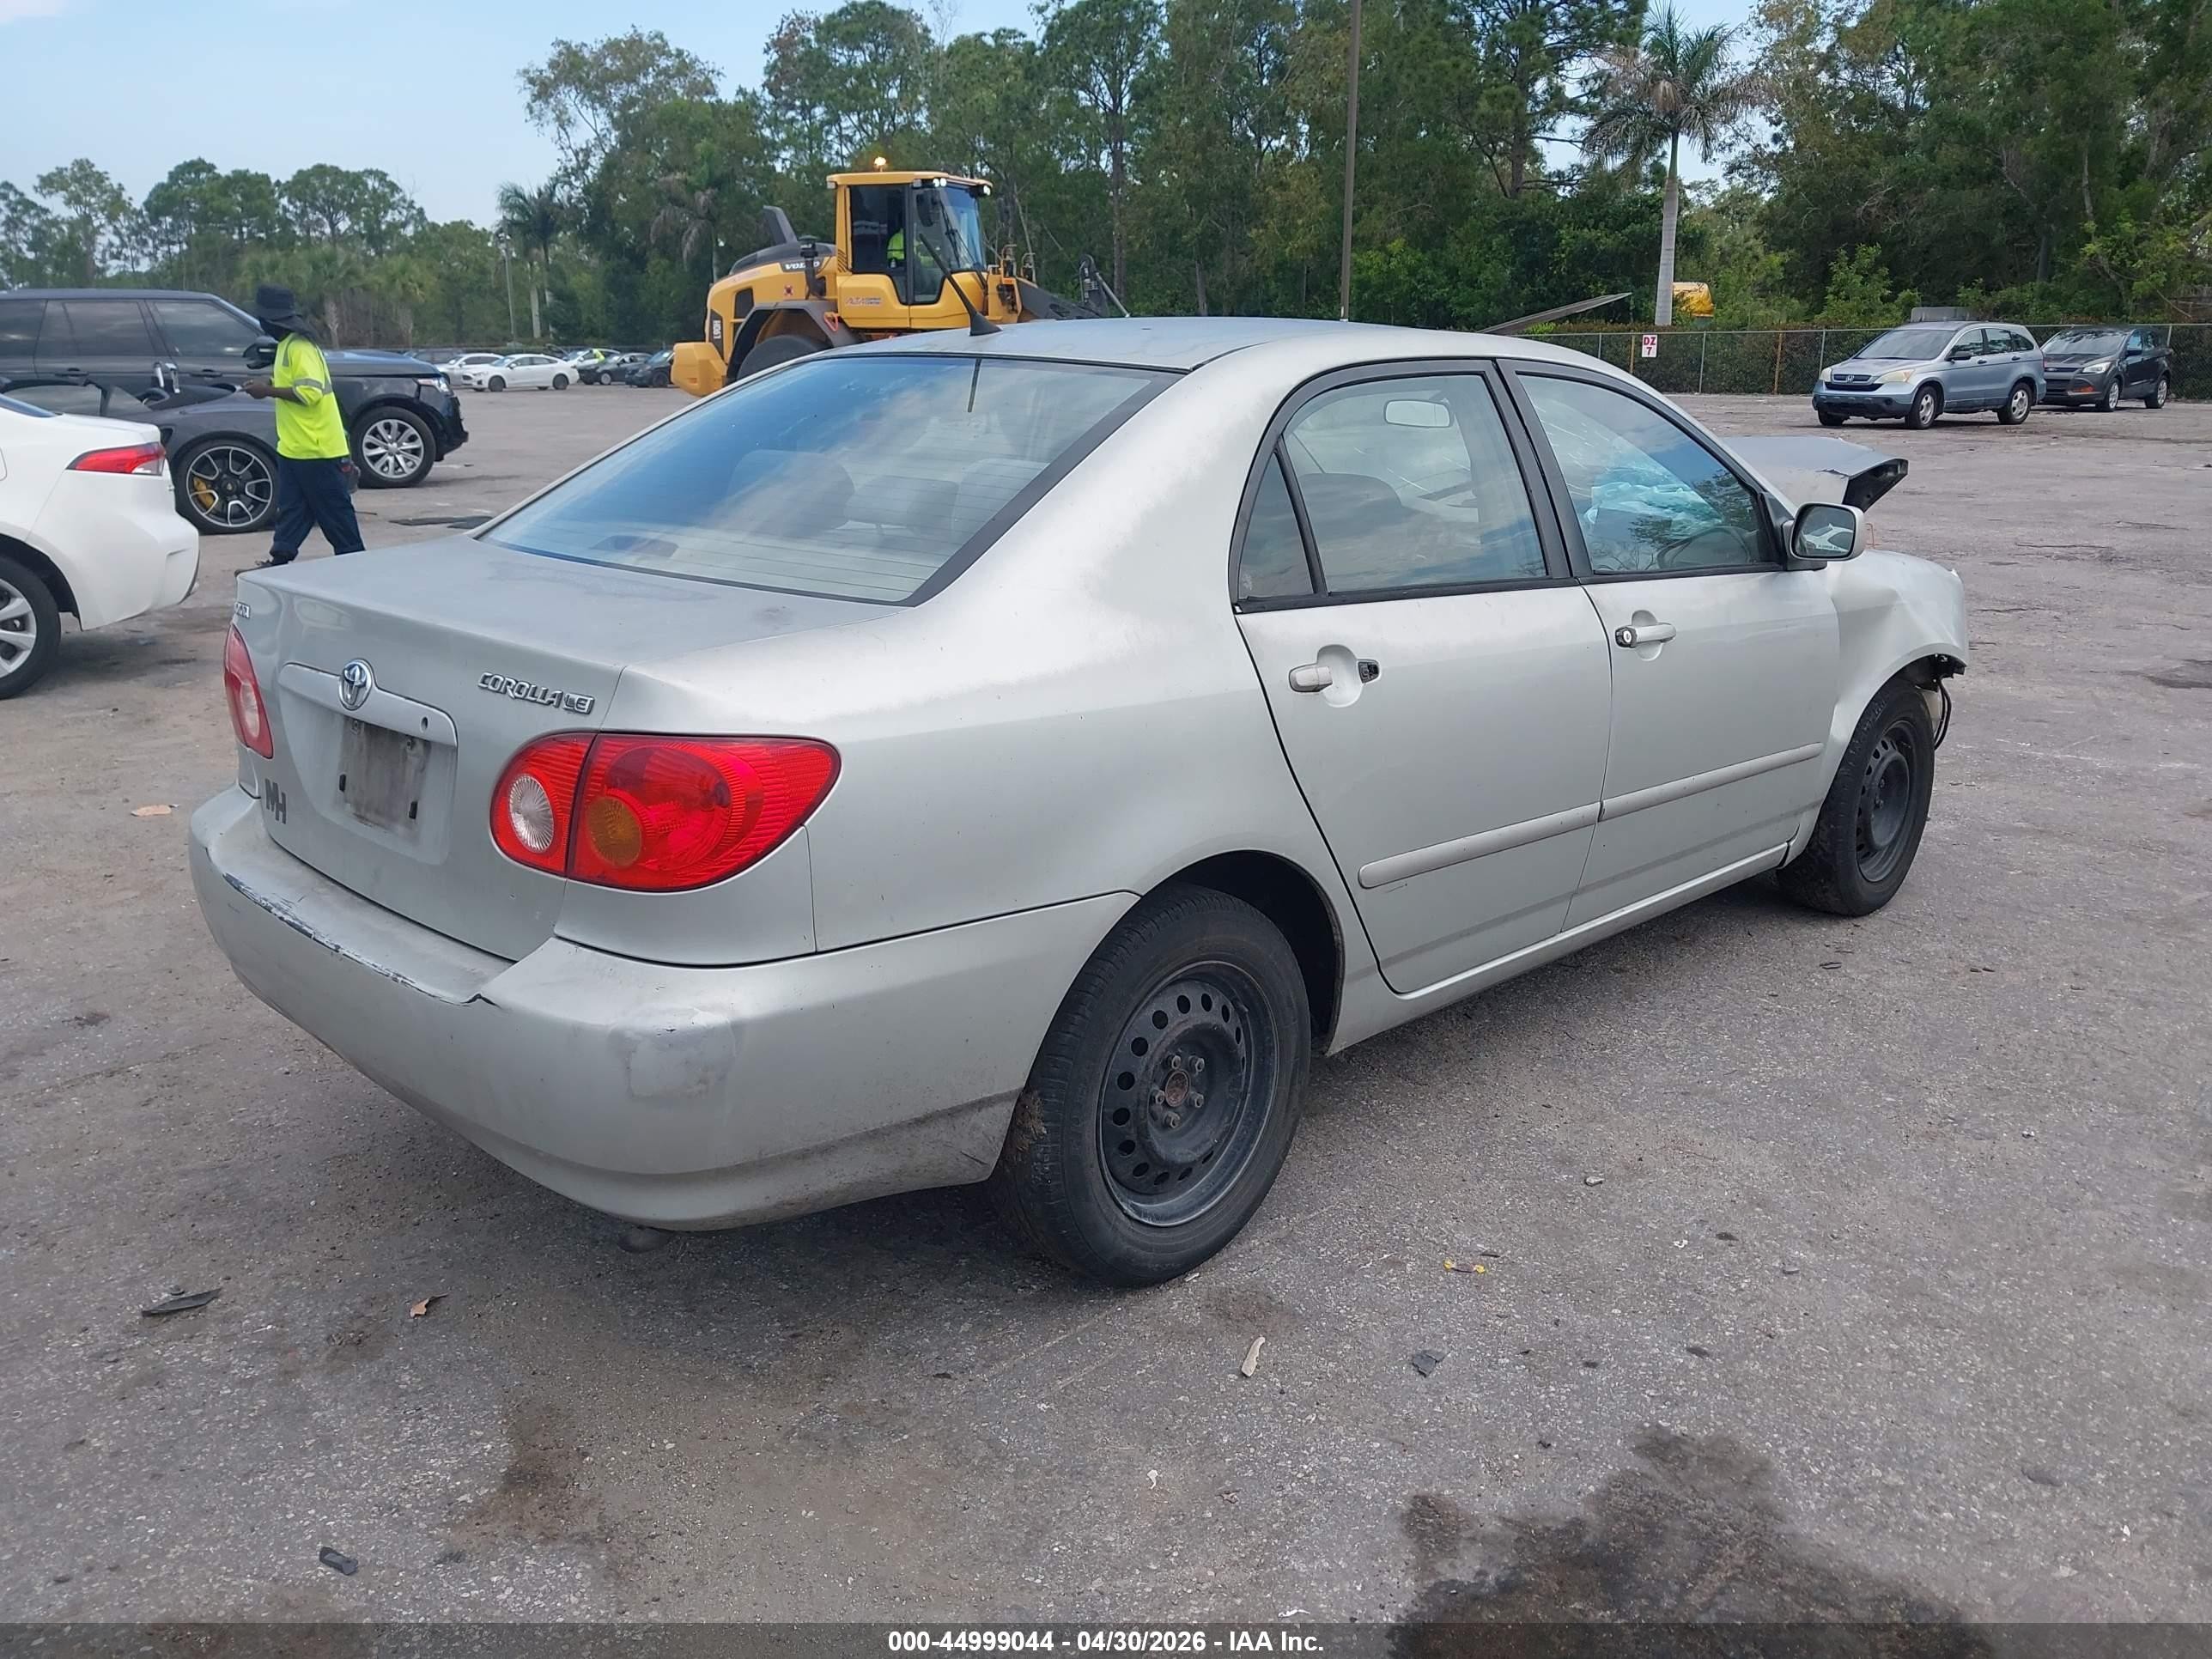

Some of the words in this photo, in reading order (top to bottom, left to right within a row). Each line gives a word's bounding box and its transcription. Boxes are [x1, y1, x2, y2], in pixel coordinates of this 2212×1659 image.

[785, 261, 820, 270] VOLO
[1644, 336, 1656, 345] DZ
[1646, 346, 1652, 356] 7
[477, 672, 563, 708] COROLLA
[562, 692, 595, 715] LE
